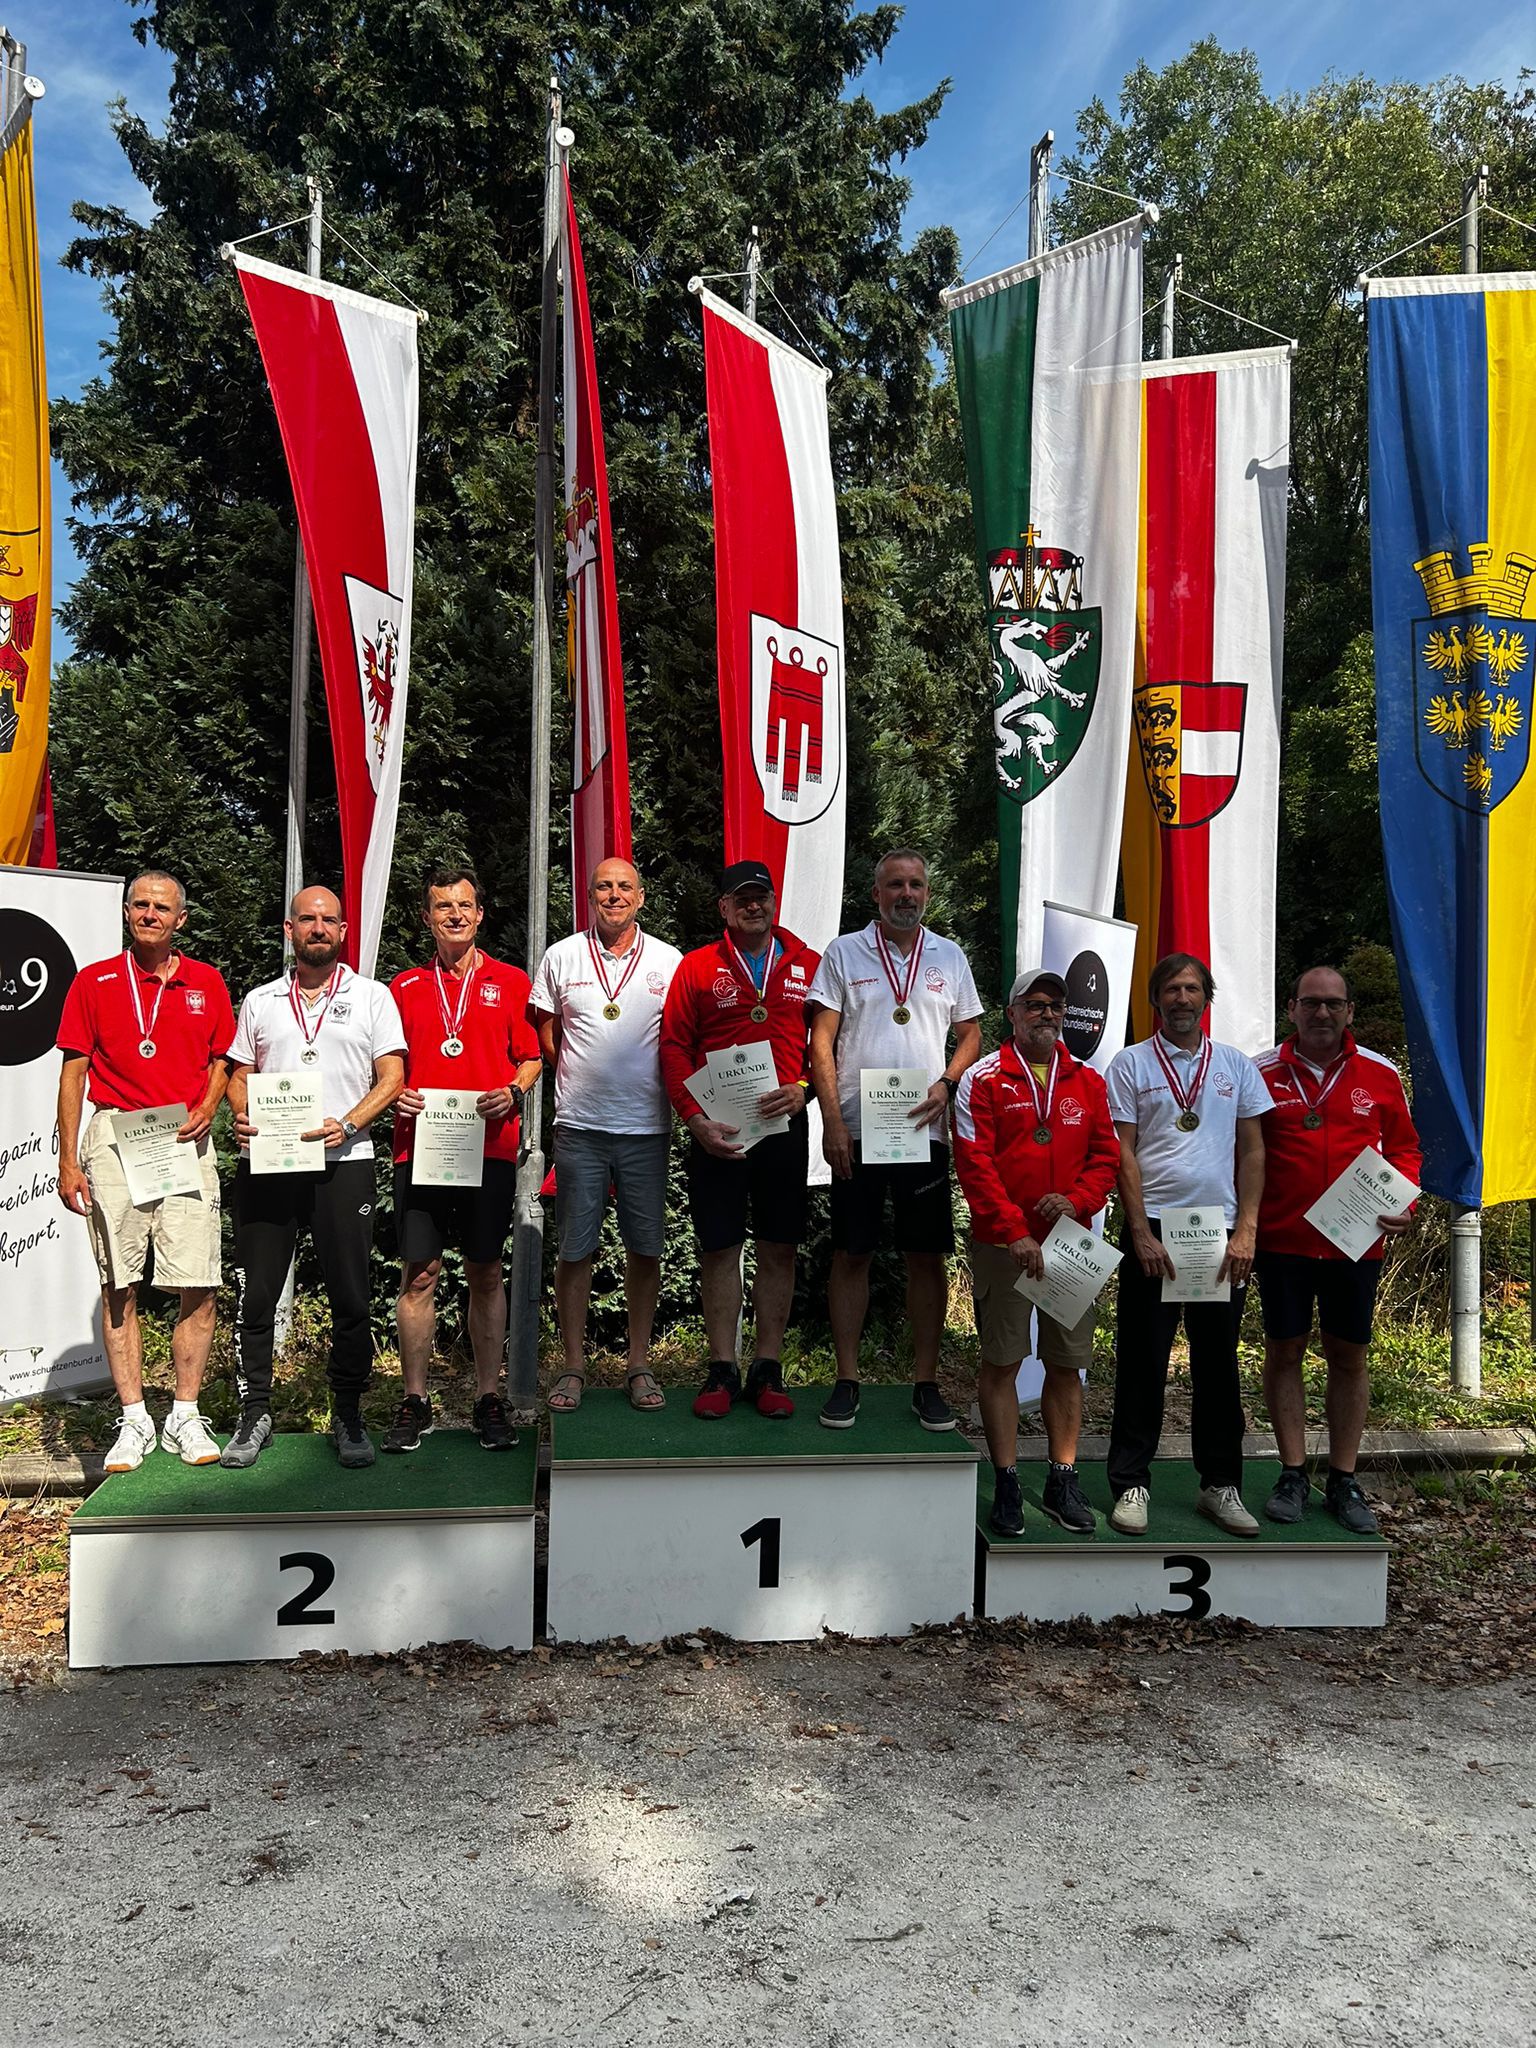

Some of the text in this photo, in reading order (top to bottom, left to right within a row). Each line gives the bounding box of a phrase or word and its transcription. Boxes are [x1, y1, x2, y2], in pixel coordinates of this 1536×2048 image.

[1063, 1017, 1094, 1034] bundesliga
[718, 1062, 769, 1080] URKUNDE
[257, 1094, 316, 1105] URKUNDE
[868, 1090, 921, 1099] URKUNDE
[425, 1111, 479, 1121] URKUNDE
[124, 1121, 182, 1139] URKUNDE
[1355, 1167, 1401, 1208] URKUNDE
[1170, 1228, 1222, 1239] URKUNDE
[1054, 1237, 1105, 1276] URKUNDE
[8, 1354, 103, 1381] www.schuetzenbund.at
[739, 1517, 782, 1589] 1
[276, 1551, 337, 1627] 2
[1160, 1554, 1212, 1620] 3
